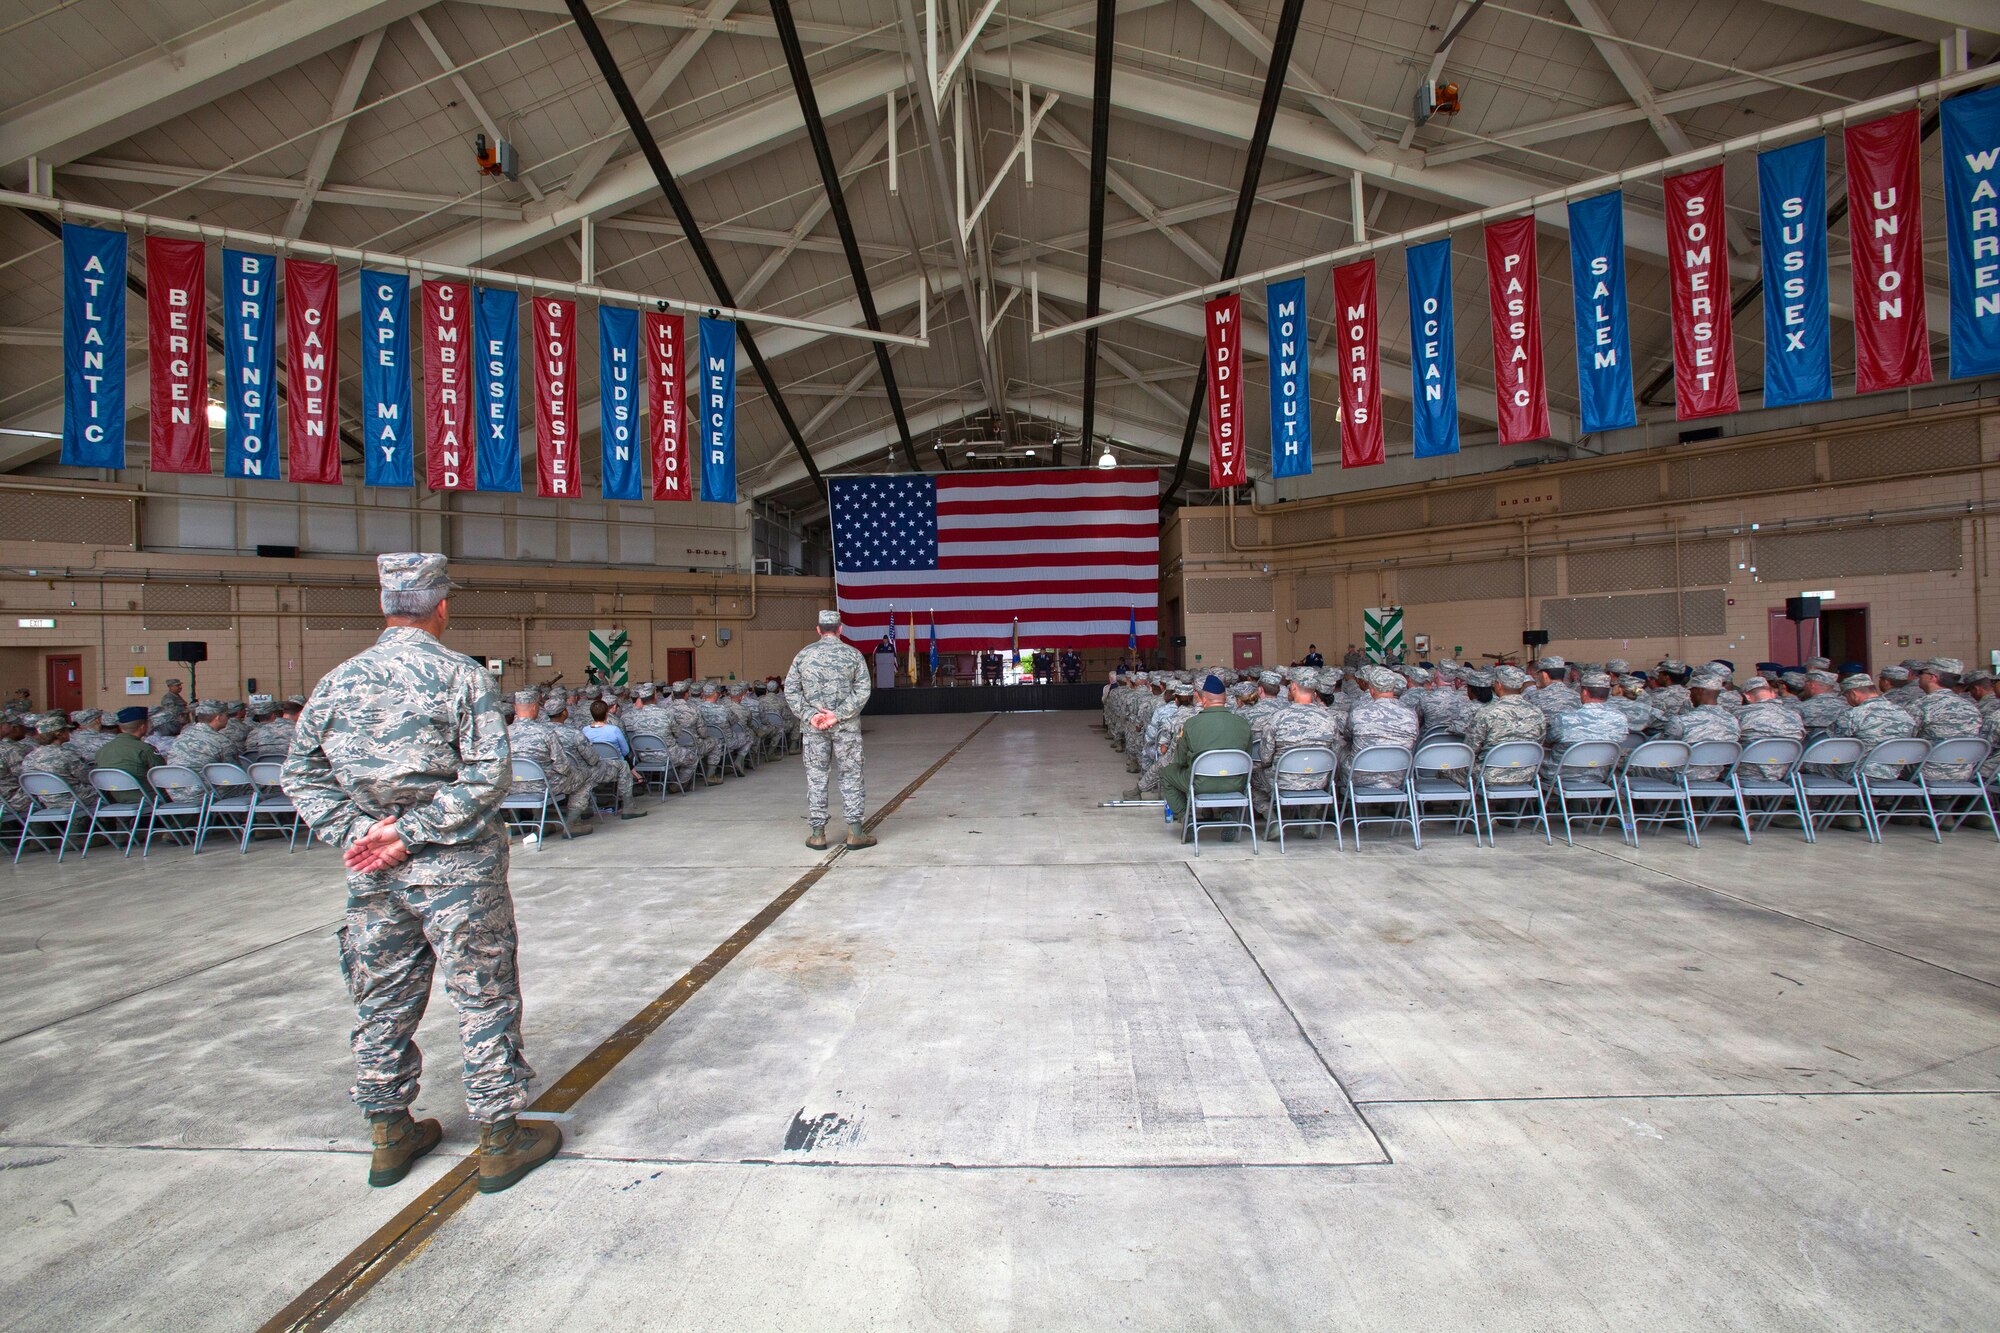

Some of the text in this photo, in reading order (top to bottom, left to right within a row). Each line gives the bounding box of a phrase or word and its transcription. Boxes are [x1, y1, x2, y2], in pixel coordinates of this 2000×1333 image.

[1687, 197, 1714, 390] SOMERSET
[1783, 198, 1805, 351] SUSSEX
[1874, 188, 1901, 320] UNION
[1966, 148, 2000, 316] WARREN
[85, 256, 103, 442] ATLANTIC
[170, 289, 189, 424] BERGEN
[243, 258, 260, 475] BURLINGTON
[303, 309, 324, 436] CAMDEN
[379, 286, 397, 461] CAPE MAY
[439, 286, 458, 486] CUMBERLAND
[1279, 302, 1297, 455] MONMOUTH
[1349, 304, 1367, 423] MORRIS
[1424, 298, 1440, 400] OCEAN
[1505, 255, 1529, 406] PASSAIC
[1592, 257, 1615, 369] SALEM
[490, 341, 503, 438] ESSEX
[548, 303, 566, 493] GLOUCESTER
[614, 348, 628, 460] HUDSON
[660, 325, 677, 490] HUNTERDON
[710, 358, 724, 464] MERCER
[1216, 309, 1232, 475] MIDDLESEX
[30, 619, 43, 627] EXIT
